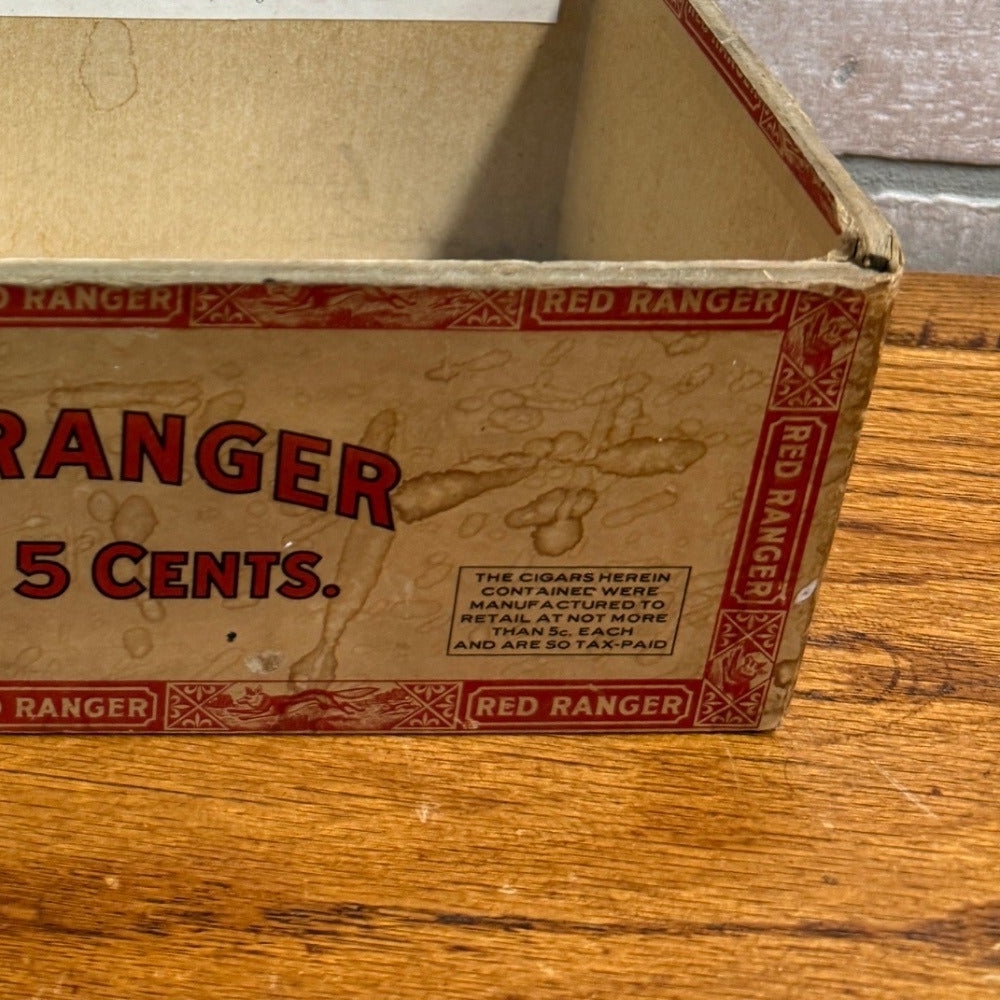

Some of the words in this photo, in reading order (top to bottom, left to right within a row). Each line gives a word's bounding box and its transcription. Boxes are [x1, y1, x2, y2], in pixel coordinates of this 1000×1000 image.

[21, 285, 173, 311] RANGER
[541, 289, 615, 313] RED
[626, 289, 779, 313] RANGER
[773, 424, 813, 479] RED
[743, 488, 797, 599] RANGER
[13, 540, 72, 600] 5
[475, 572, 514, 583] THE
[518, 572, 594, 583] CIGARS
[597, 572, 672, 583] HEREIN
[480, 586, 597, 597] CONTAINED
[601, 586, 660, 597] WERE
[469, 600, 635, 610] MANUFACTURED
[640, 600, 666, 610] TO
[460, 613, 531, 624] RETAIL
[536, 613, 563, 624] AT
[566, 613, 607, 624] NOT
[610, 613, 668, 624] MORE
[491, 626, 544, 637] THAN
[578, 627, 634, 637] EACH
[453, 640, 496, 650] AND
[500, 640, 541, 650] ARE
[545, 640, 571, 650] SO
[575, 640, 668, 650] TAX-PAID
[15, 697, 149, 718] RANGER
[475, 696, 539, 717] RED
[549, 694, 684, 717] RANGER
